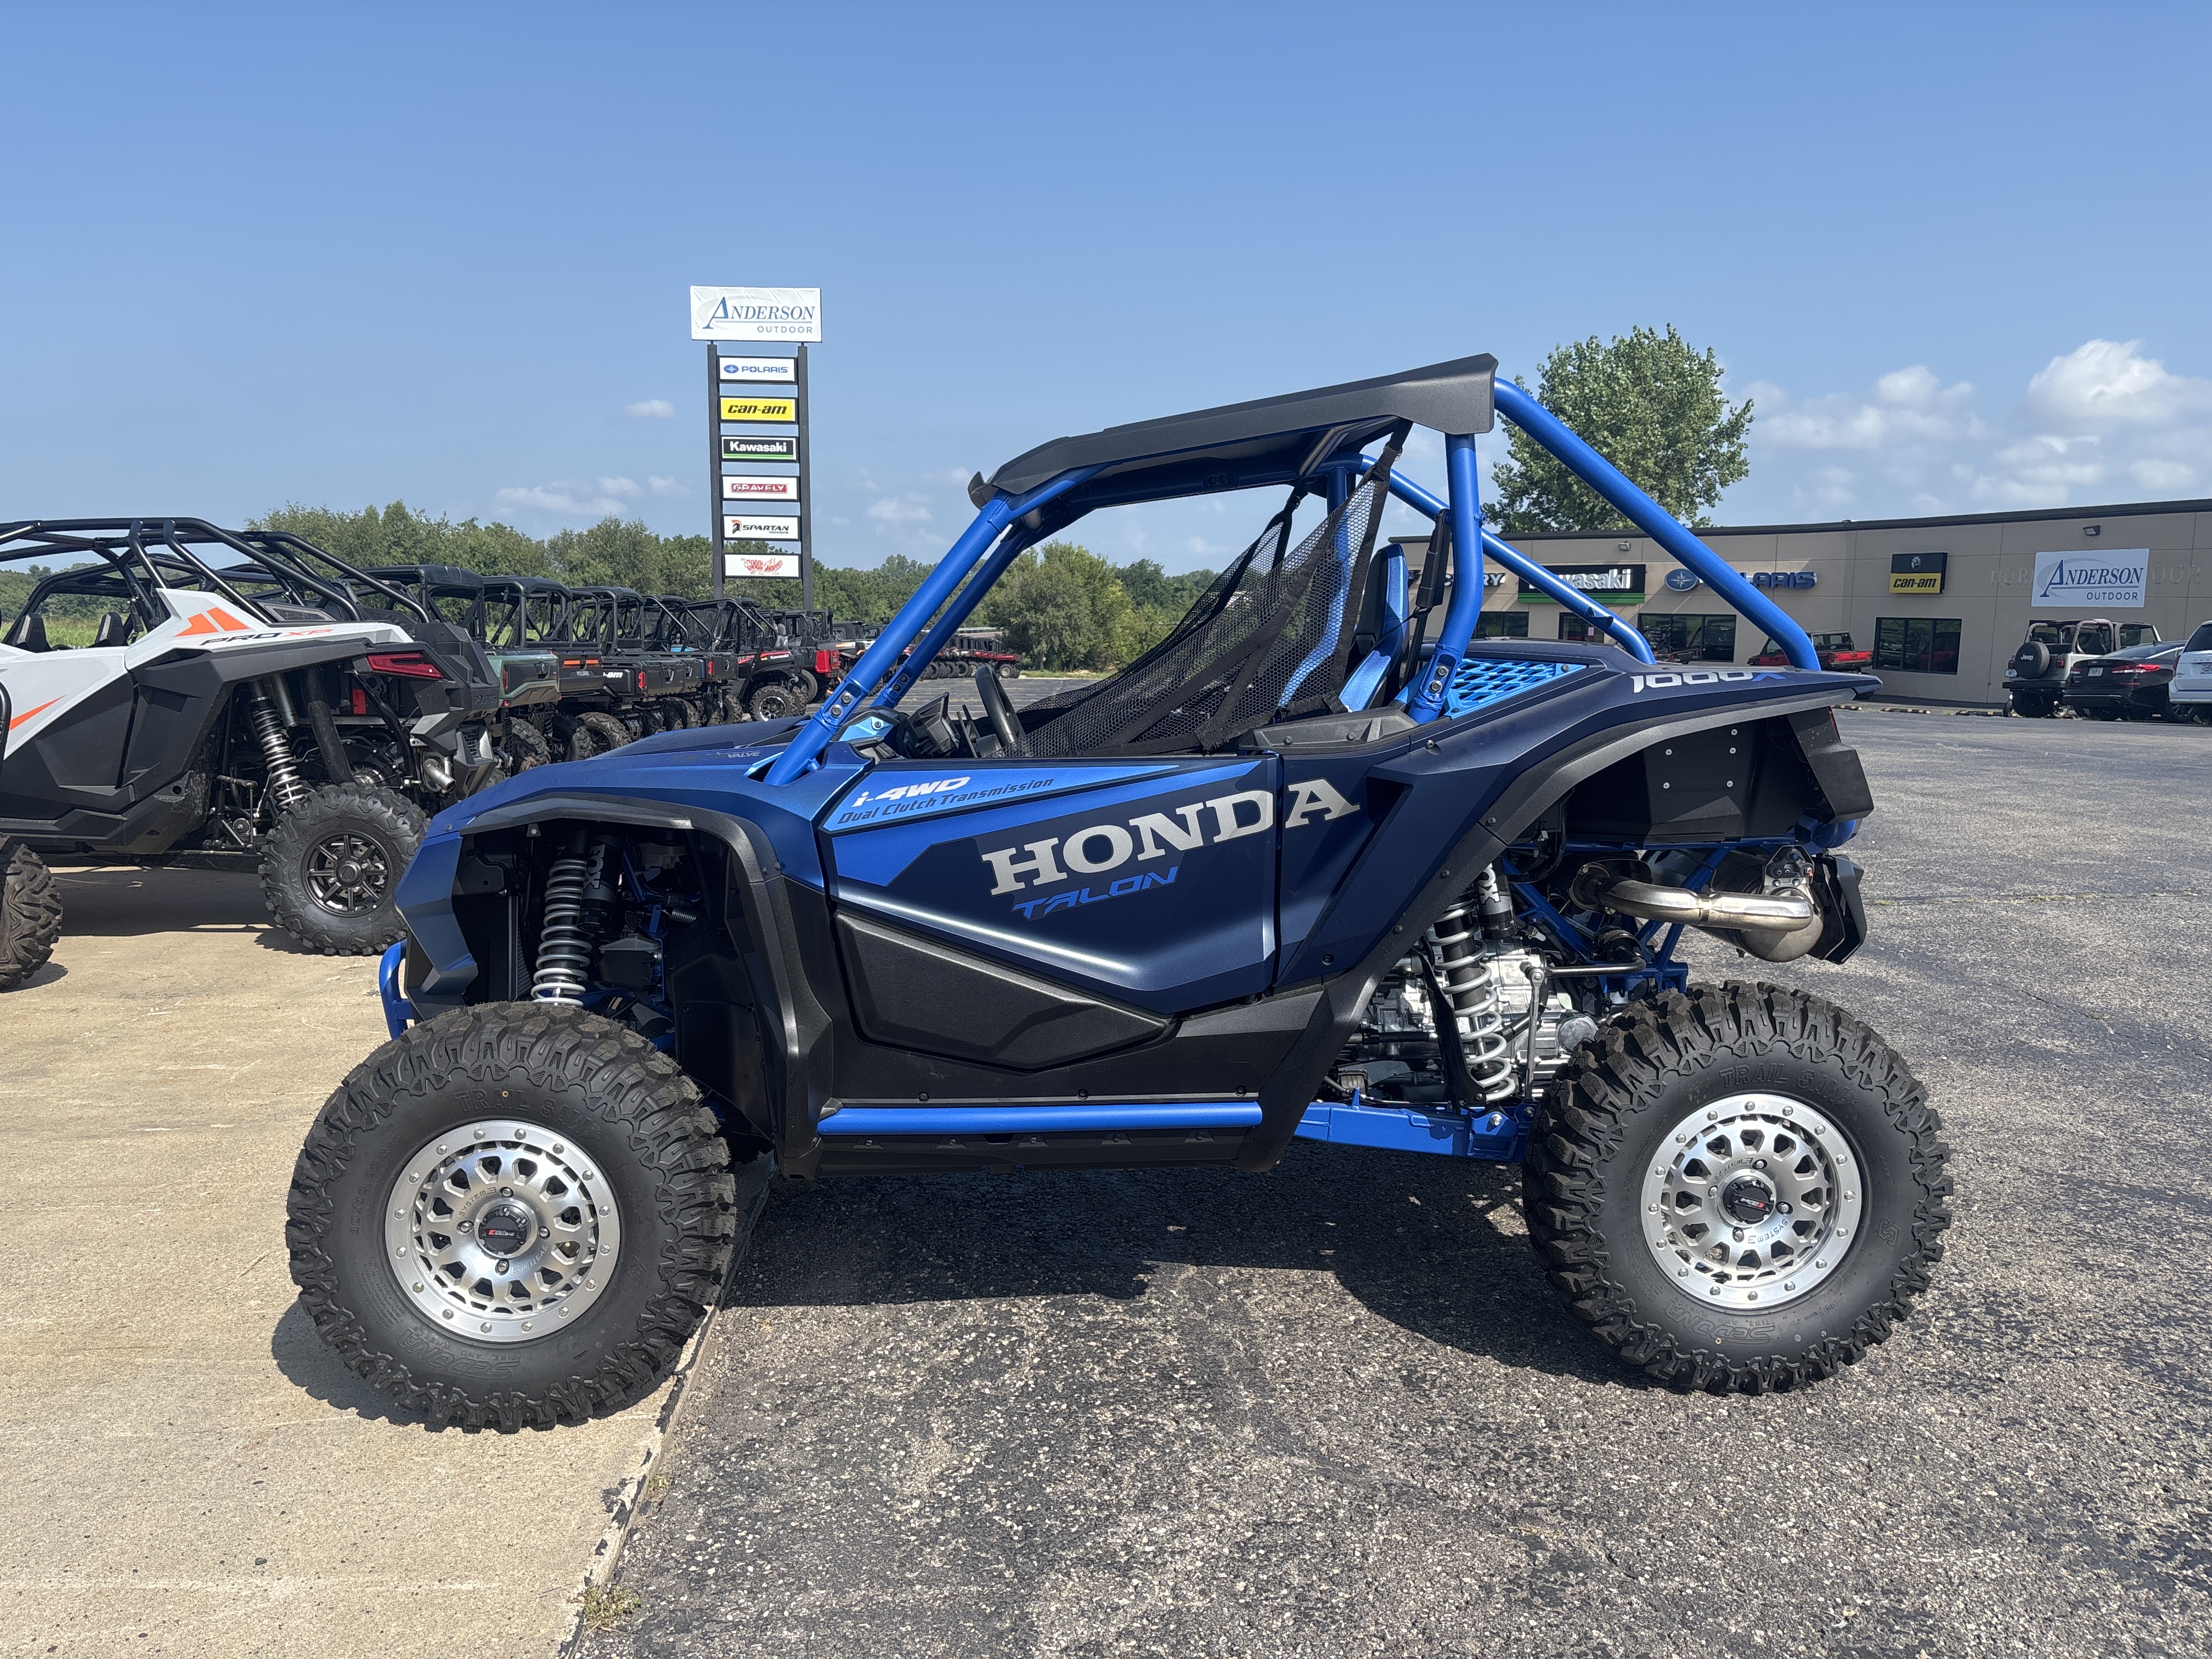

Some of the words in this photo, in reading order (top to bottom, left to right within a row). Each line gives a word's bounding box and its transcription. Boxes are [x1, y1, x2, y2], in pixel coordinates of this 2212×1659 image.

[702, 297, 815, 329] ANDERSON
[727, 405, 787, 415] can-am
[730, 441, 787, 452] Kawasaki
[733, 484, 785, 493] GRAVELY
[1529, 568, 1632, 589] wasaki
[1893, 578, 1937, 588] can-am
[2040, 560, 2145, 597] ANDERSON
[2086, 592, 2138, 601] OUTDOOR
[199, 632, 283, 646] PRO
[2020, 653, 2034, 662] Jeep
[837, 807, 881, 825] Dual
[882, 797, 936, 816] Clutch
[939, 778, 1054, 805] Transmission
[851, 776, 971, 808] i-4WD
[981, 777, 1362, 896] HONDA
[583, 844, 606, 890] FOX
[1013, 865, 1179, 919] TALON
[1477, 862, 1501, 904] OX
[1719, 1063, 1788, 1089] TRAIL
[453, 1088, 531, 1113] TRAIL
[1664, 1299, 1775, 1345] SEDONA
[397, 1329, 521, 1380] SEDONA
